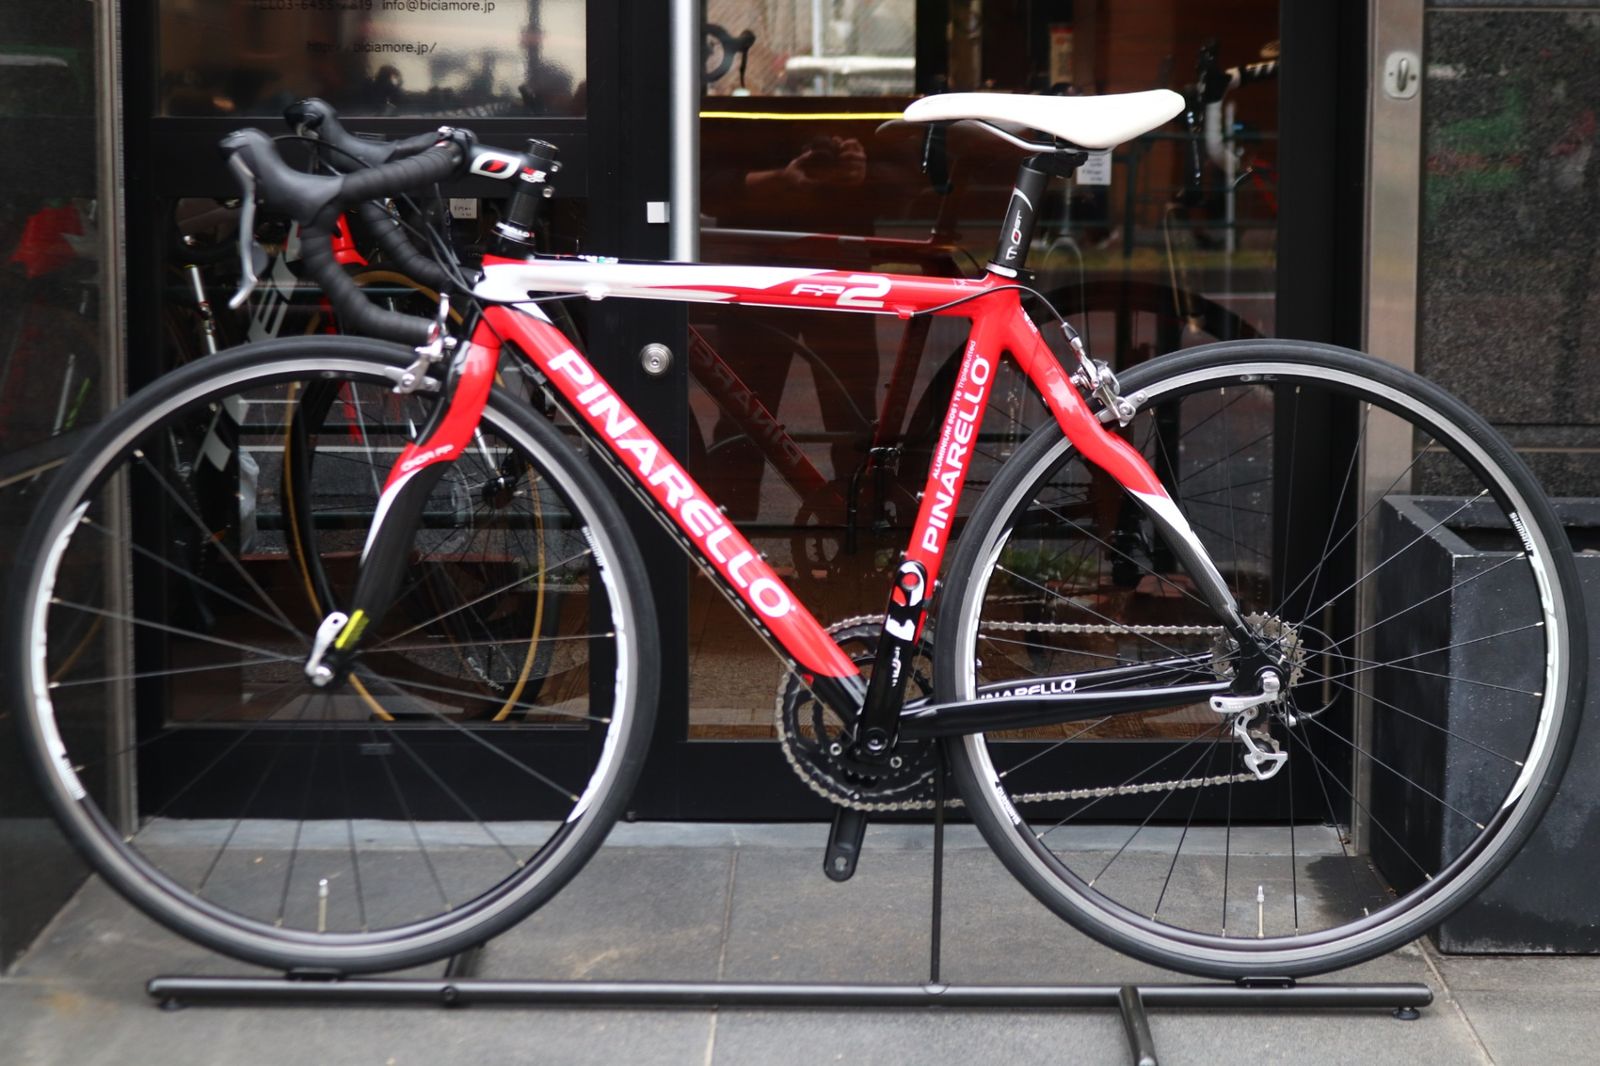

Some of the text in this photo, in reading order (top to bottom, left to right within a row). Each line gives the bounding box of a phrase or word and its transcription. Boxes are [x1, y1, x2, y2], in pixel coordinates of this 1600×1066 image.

[382, 0, 495, 14] info@biciamore.jp
[548, 349, 791, 617] PINARELLO
[922, 357, 990, 553] PINARELLO
[933, 425, 952, 479] ALUMINIUM
